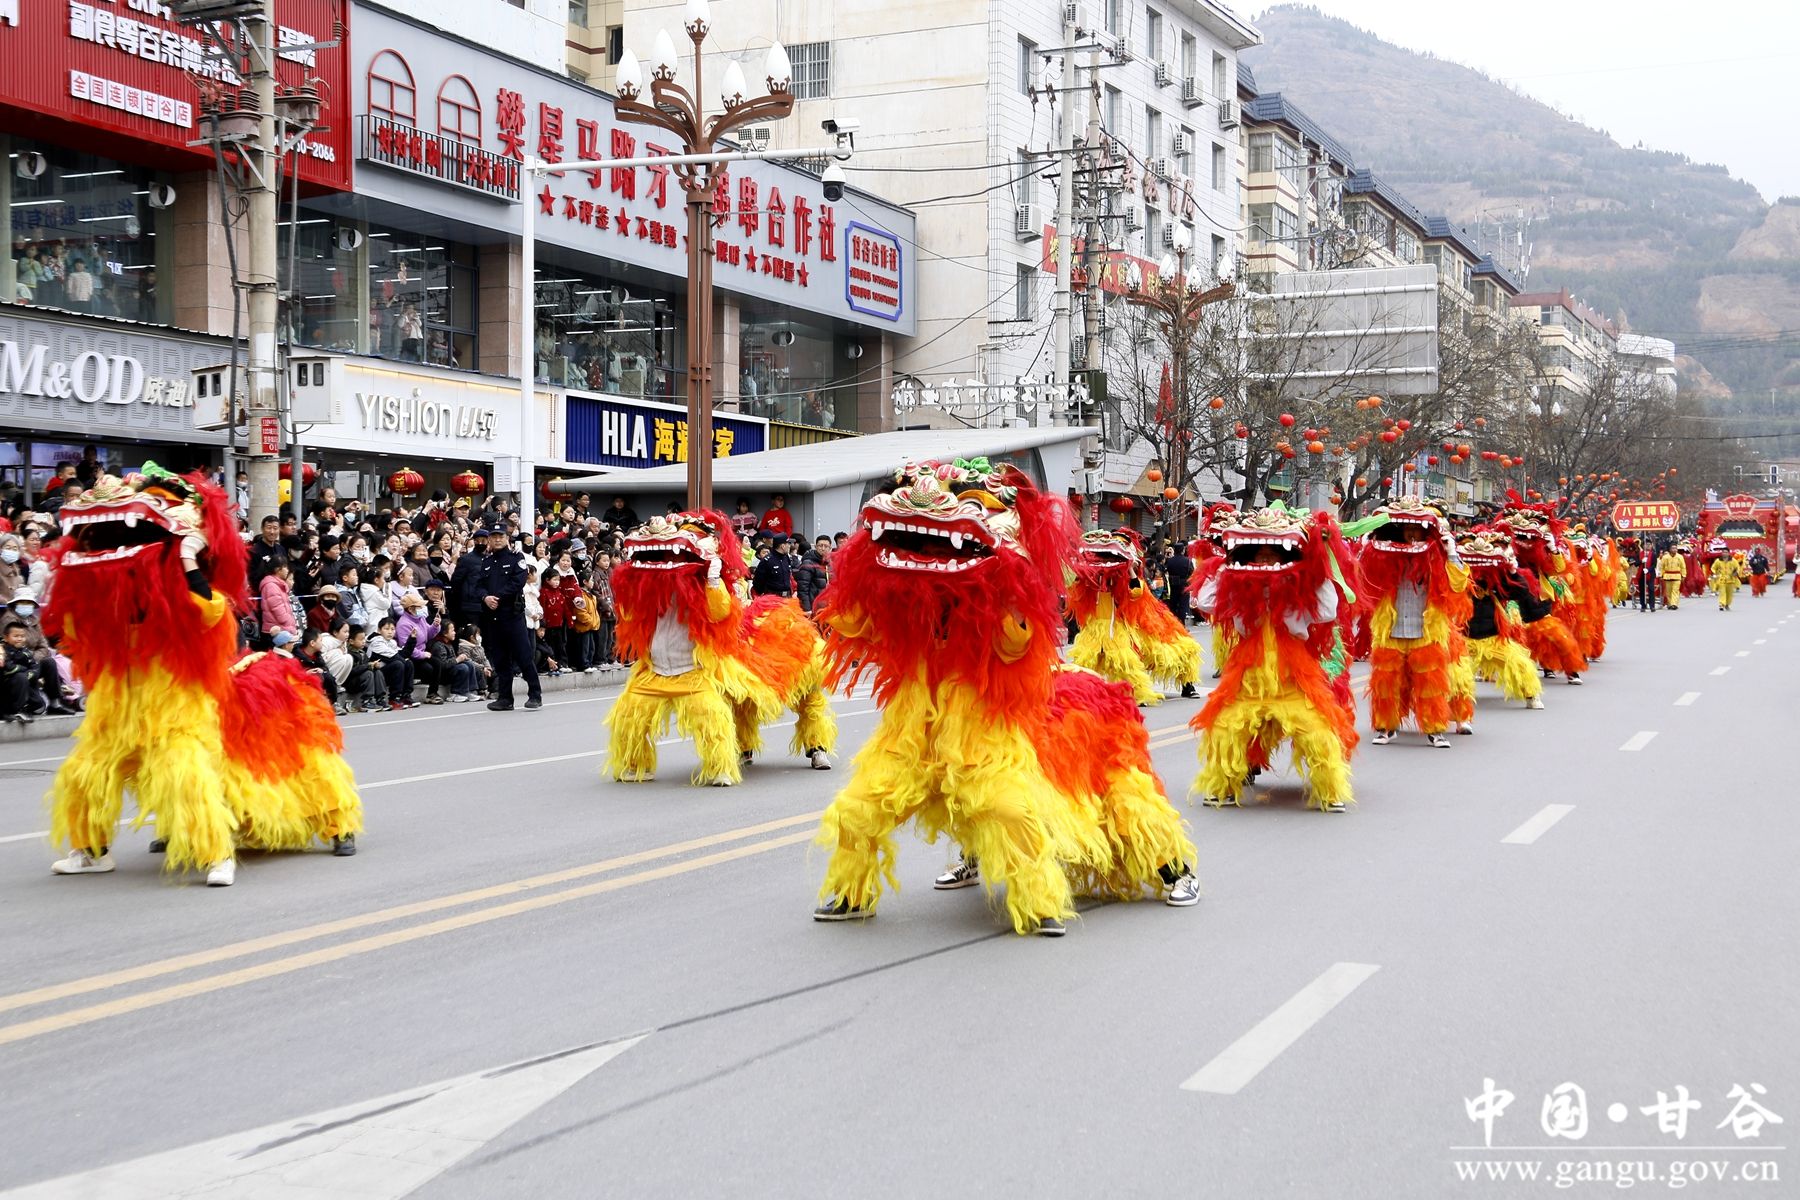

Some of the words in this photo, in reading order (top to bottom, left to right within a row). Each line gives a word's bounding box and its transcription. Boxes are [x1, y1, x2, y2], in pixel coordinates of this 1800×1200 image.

[73, 74, 189, 122] 全国连锁甘谷店
[711, 238, 740, 266] 限时
[142, 376, 192, 407] 欧迪
[602, 410, 648, 459] HLA
[654, 417, 734, 461] 海澜家
[1632, 517, 1661, 528] 舞狮队
